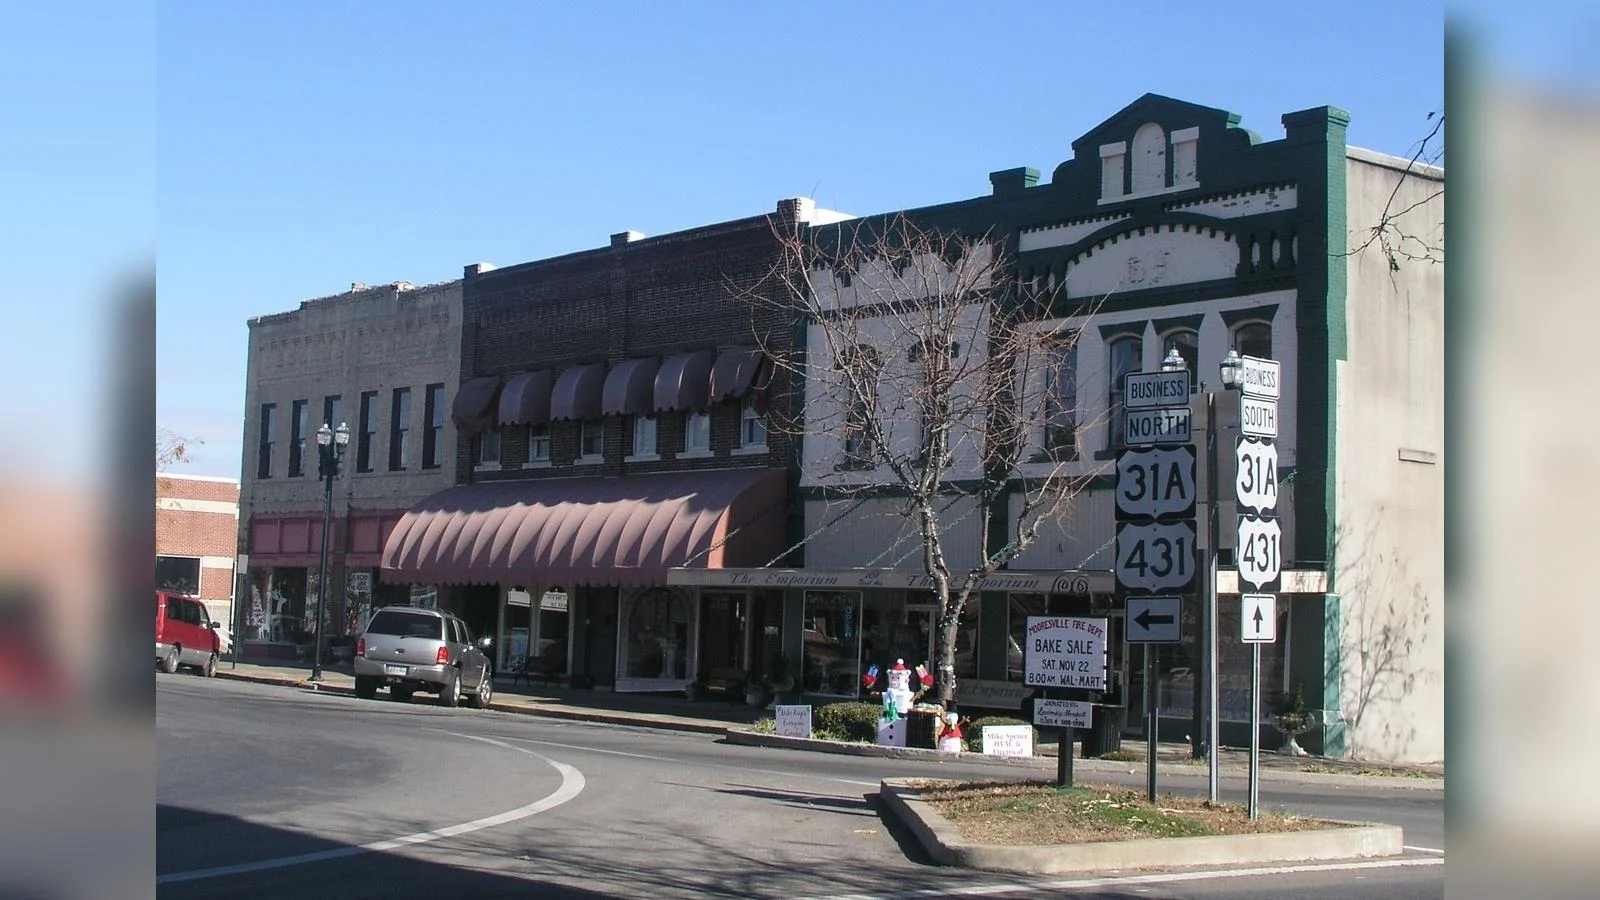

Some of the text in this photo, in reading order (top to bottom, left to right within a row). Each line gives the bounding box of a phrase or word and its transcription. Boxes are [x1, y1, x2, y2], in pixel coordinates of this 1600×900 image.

[1245, 367, 1276, 389] BUSINESS
[1131, 380, 1184, 399] BUSINESS
[1129, 414, 1188, 437] NORTH
[1244, 405, 1274, 429] SOUTH
[1124, 461, 1187, 501] 31A
[1241, 453, 1276, 497] 31A
[1124, 536, 1185, 578] 431
[1243, 532, 1277, 573] 431
[730, 571, 838, 586] The Emporium
[950, 574, 1039, 589] Eporium
[1028, 619, 1070, 636] MOORESVILLE
[1073, 620, 1086, 631] FIRE
[1035, 639, 1093, 654] BAKE SALE
[1059, 660, 1076, 671] NOV
[1078, 661, 1089, 672] 22
[1060, 674, 1101, 687] WAL-MART
